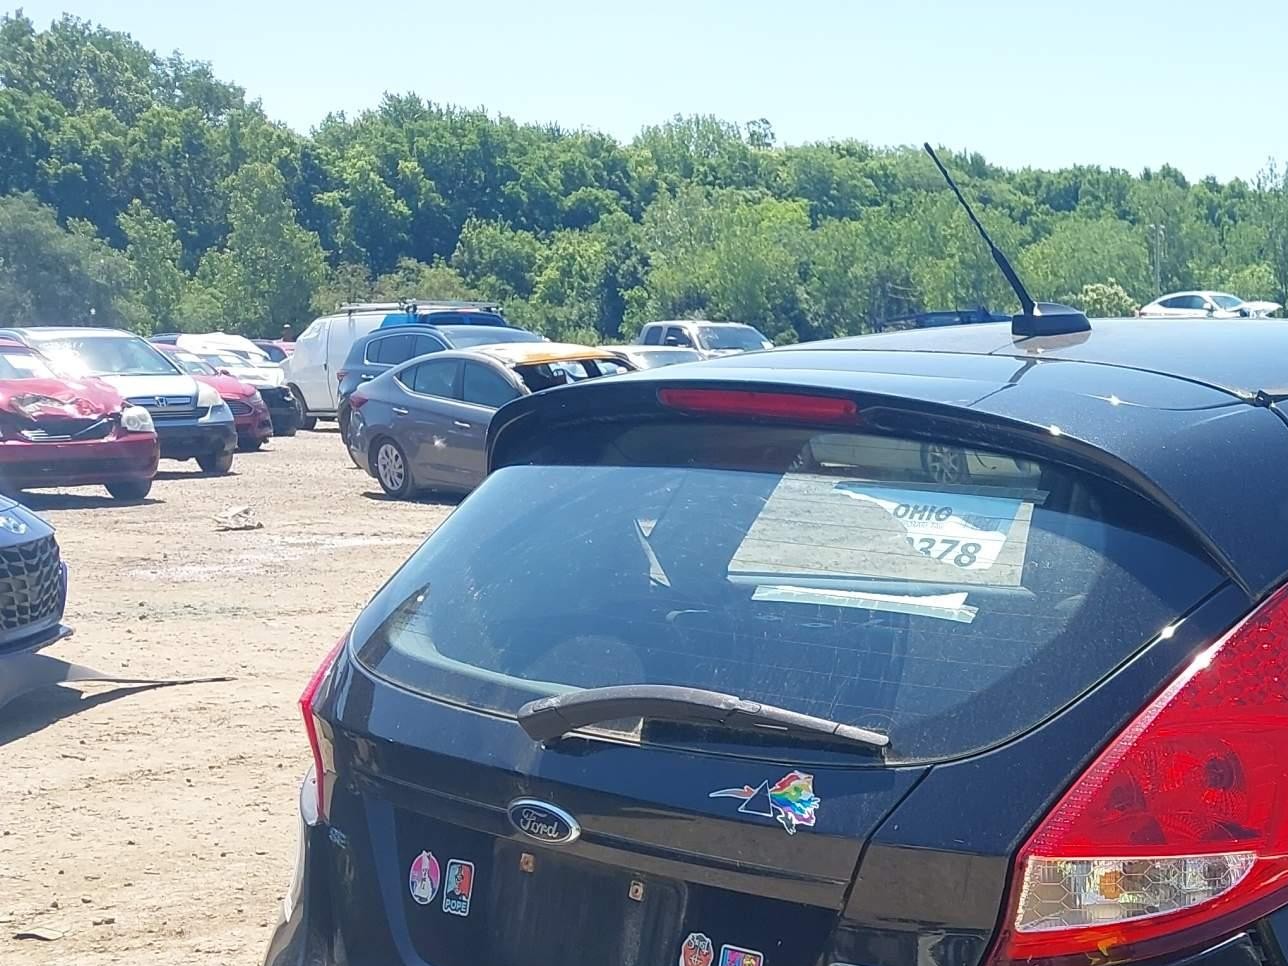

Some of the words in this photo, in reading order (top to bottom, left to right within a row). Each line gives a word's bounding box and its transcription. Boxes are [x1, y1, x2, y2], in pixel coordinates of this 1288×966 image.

[893, 503, 953, 522] OHIO
[905, 537, 982, 567] 378
[521, 806, 561, 840] Ford
[445, 898, 468, 912] POPE
